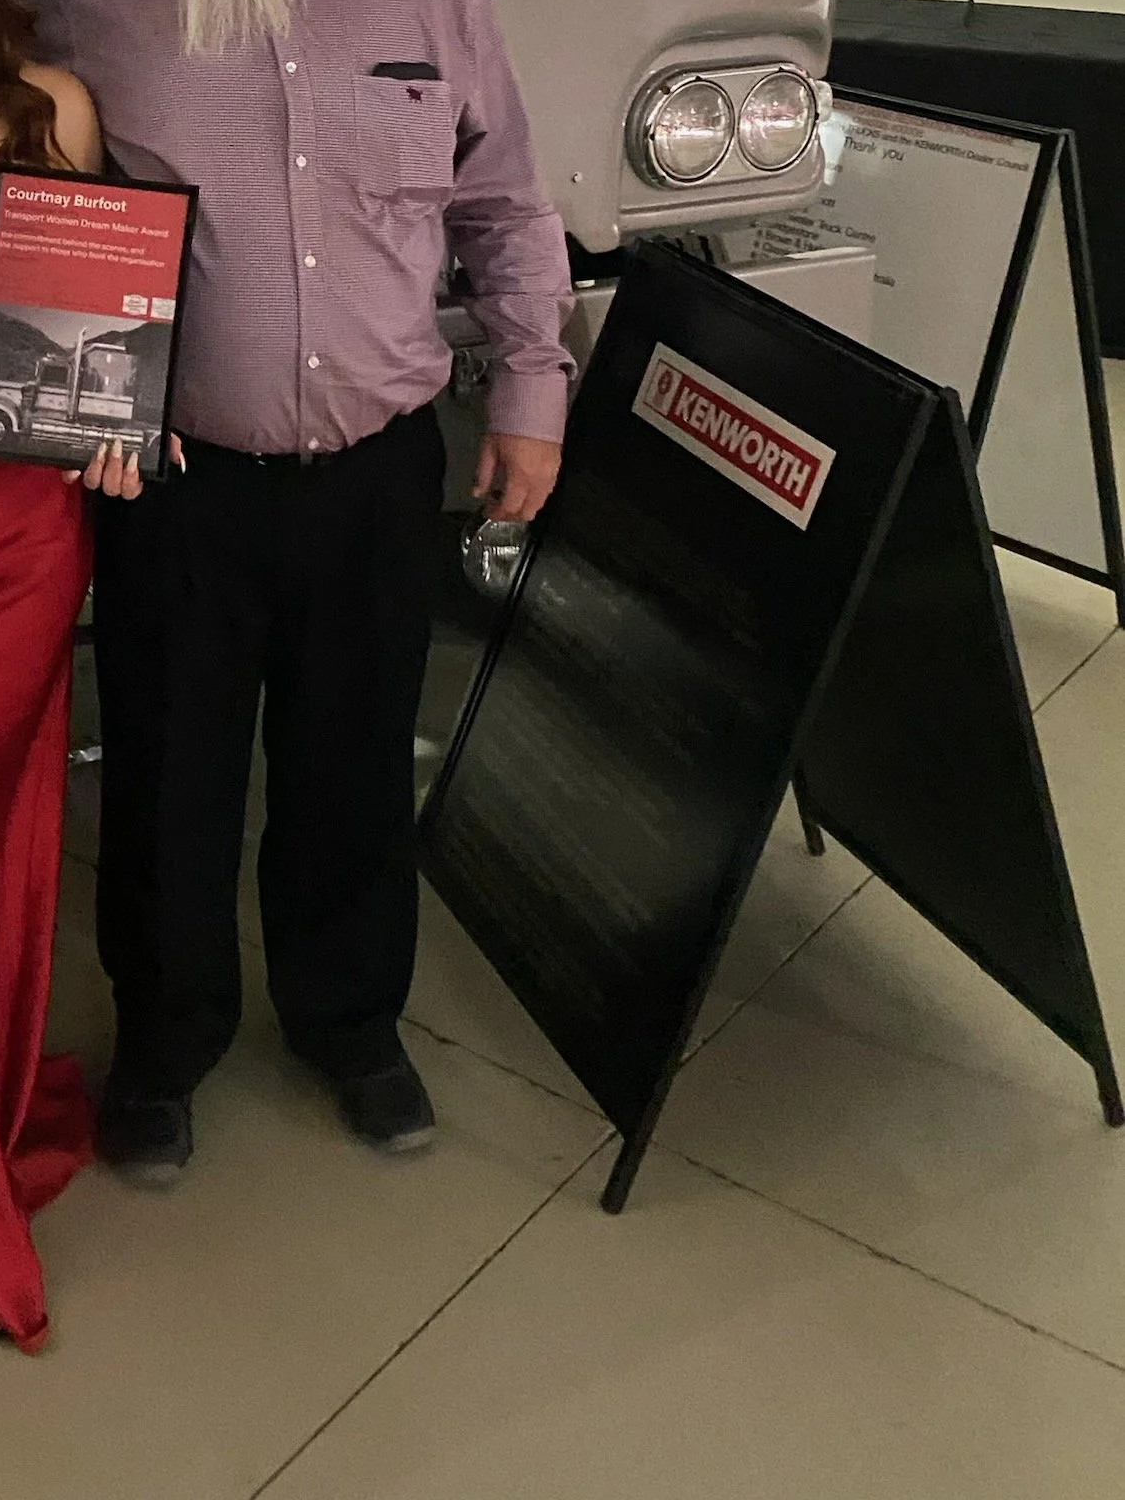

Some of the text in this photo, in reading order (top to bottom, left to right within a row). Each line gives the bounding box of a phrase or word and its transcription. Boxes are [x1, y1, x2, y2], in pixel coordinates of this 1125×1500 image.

[845, 136, 904, 162] Thank you
[6, 186, 127, 213] Courtnay Burfoot
[3, 210, 169, 238] Transport Women Dream Maker Award
[674, 386, 811, 498] KENWORTH
